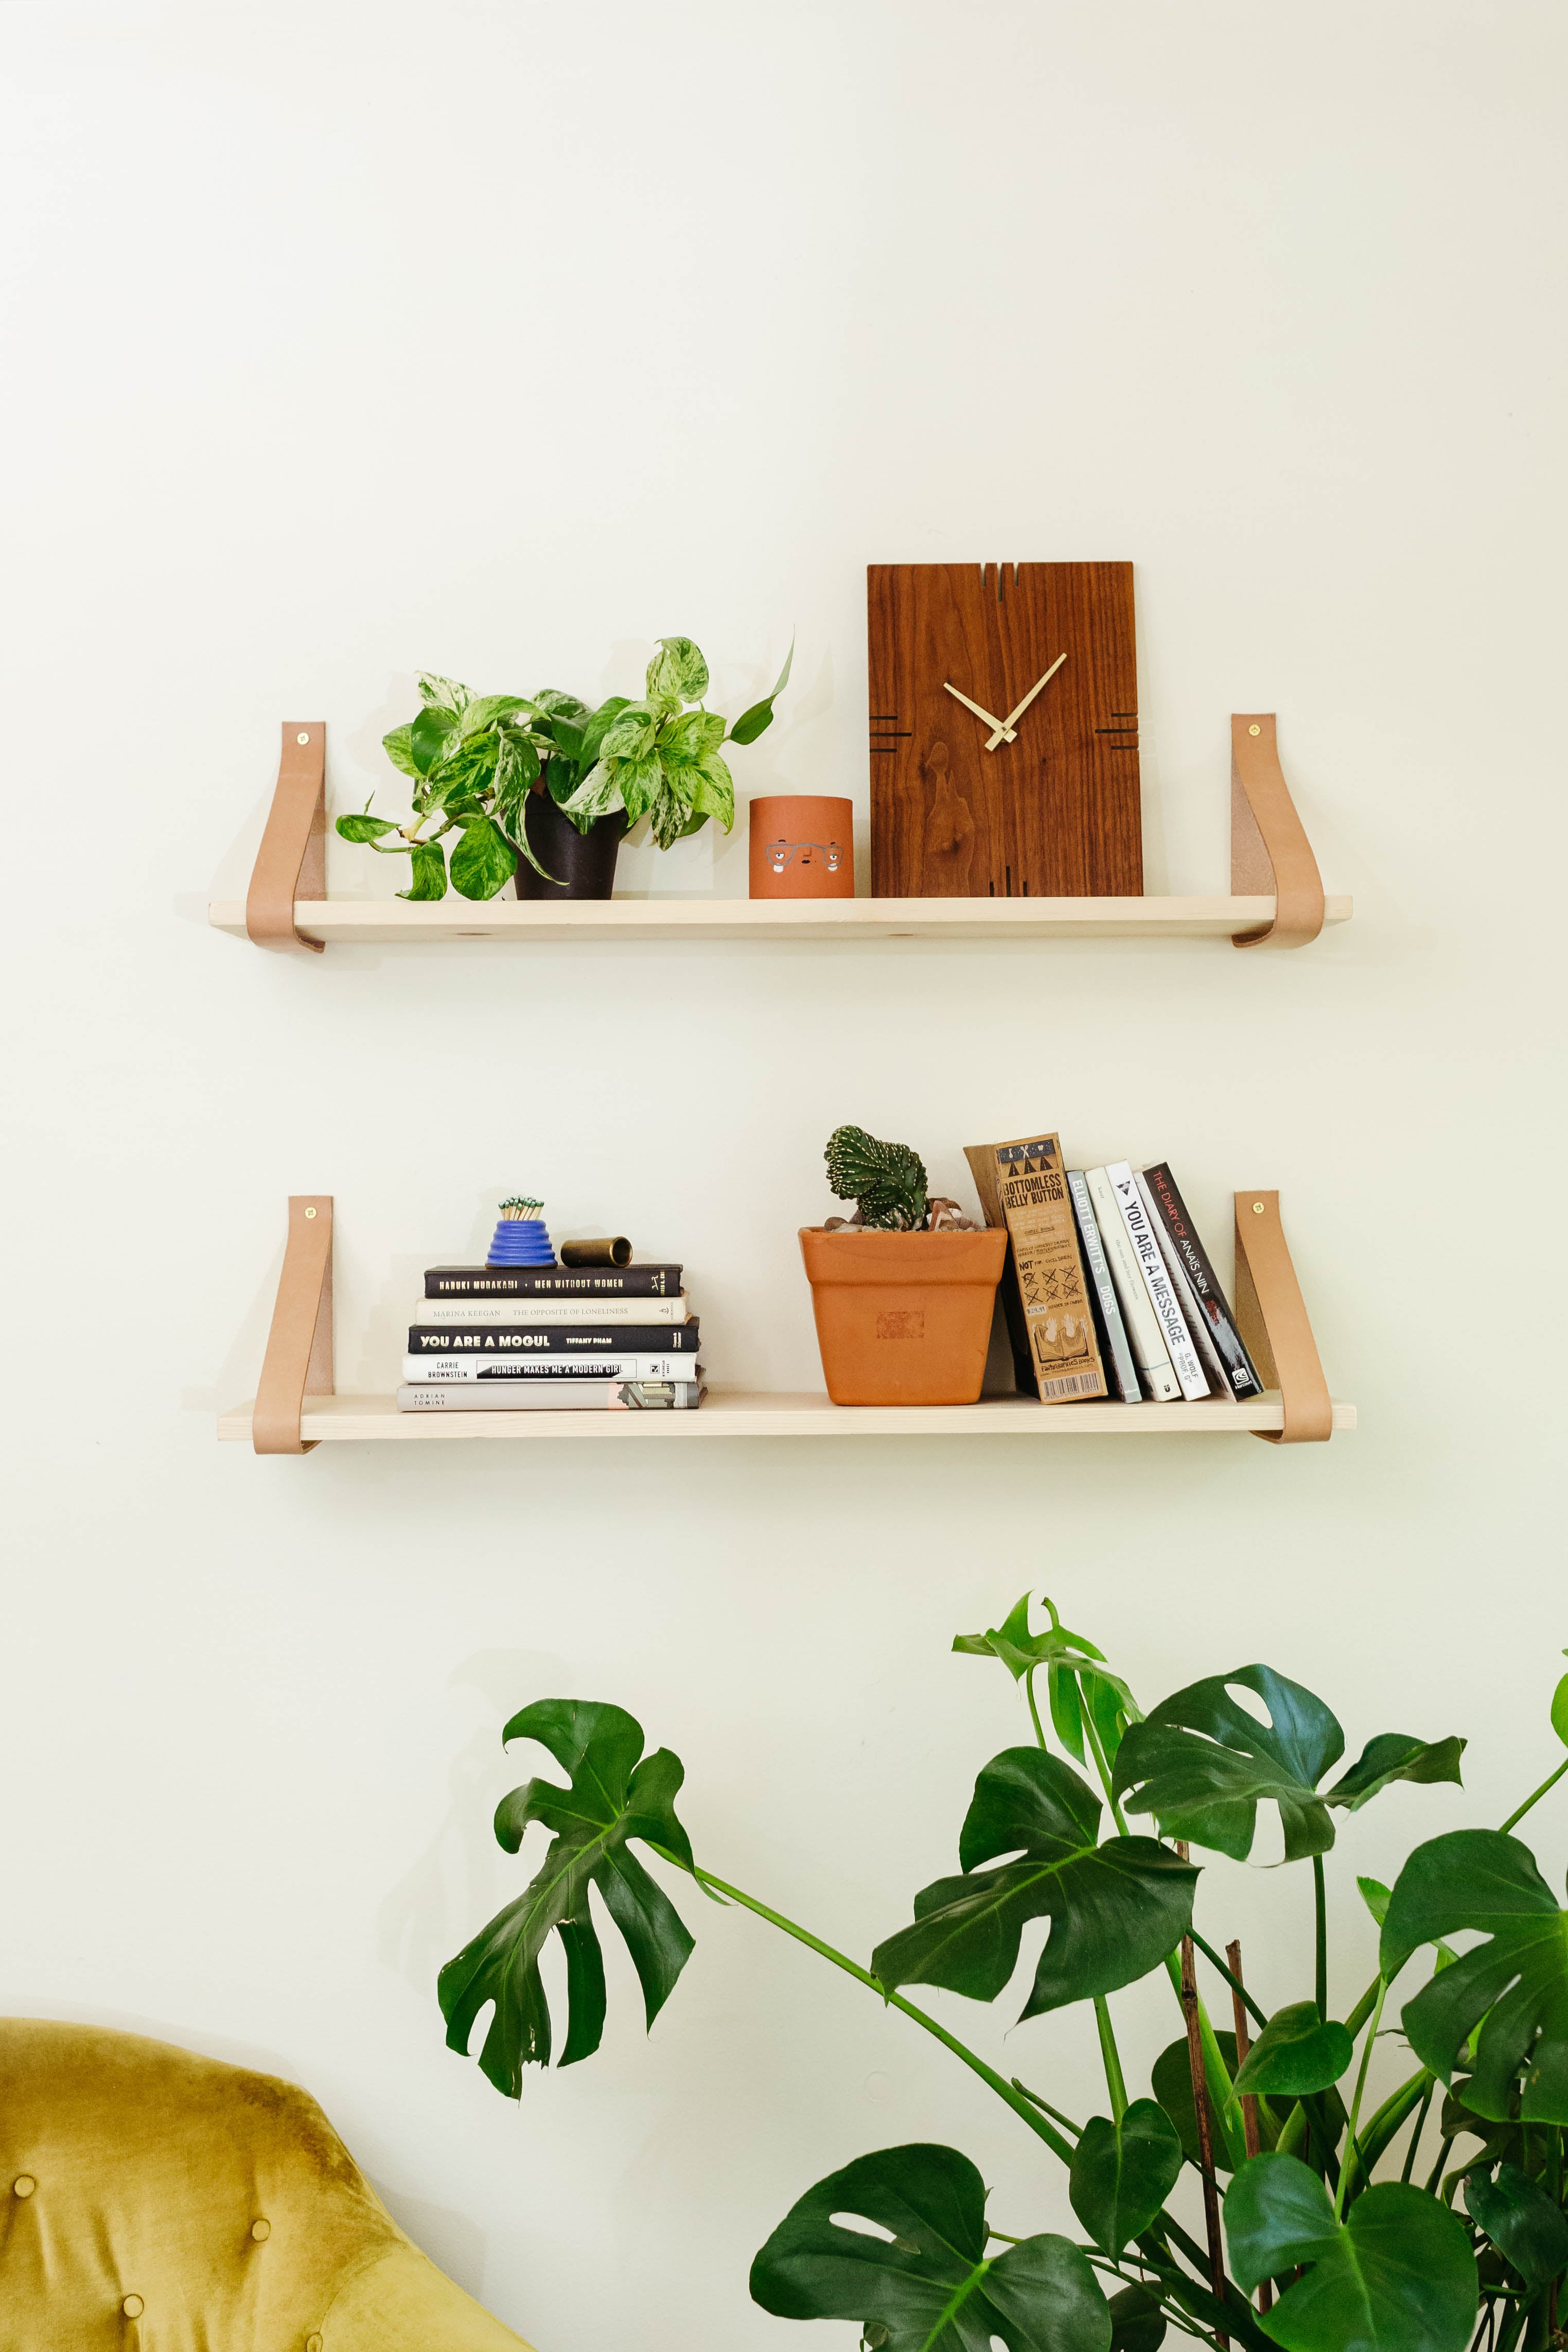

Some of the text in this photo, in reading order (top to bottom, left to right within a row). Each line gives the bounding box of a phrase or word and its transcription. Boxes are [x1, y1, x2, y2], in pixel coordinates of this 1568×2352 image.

[1003, 1173, 1061, 1196] BOTTOMLESS
[1005, 1186, 1064, 1209] BELLY BUTTON
[1153, 1170, 1210, 1294] THE DIARY OF ANAÏS NIN
[1072, 1179, 1116, 1315] ELLIOTT ERWITT'S DOGS
[1019, 1260, 1033, 1271] NOT
[1046, 1255, 1072, 1263] CHILDREN
[1125, 1201, 1186, 1345] YOU ARE A MESSAGE
[439, 1279, 623, 1290] HARUKI MURAKAMI MEN WITHOUT WOMEN
[1121, 1258, 1130, 1269] and
[1129, 1279, 1140, 1300] flowers
[420, 1336, 449, 1347] YOU
[453, 1336, 481, 1347] ARE
[485, 1336, 495, 1346] A
[499, 1335, 550, 1347] MOGUL
[491, 1364, 622, 1374] HUNGER MAKES ME A MODERN GIRL
[1187, 1360, 1199, 1378] WOLF
[1235, 1380, 1253, 1390] Harcourt
